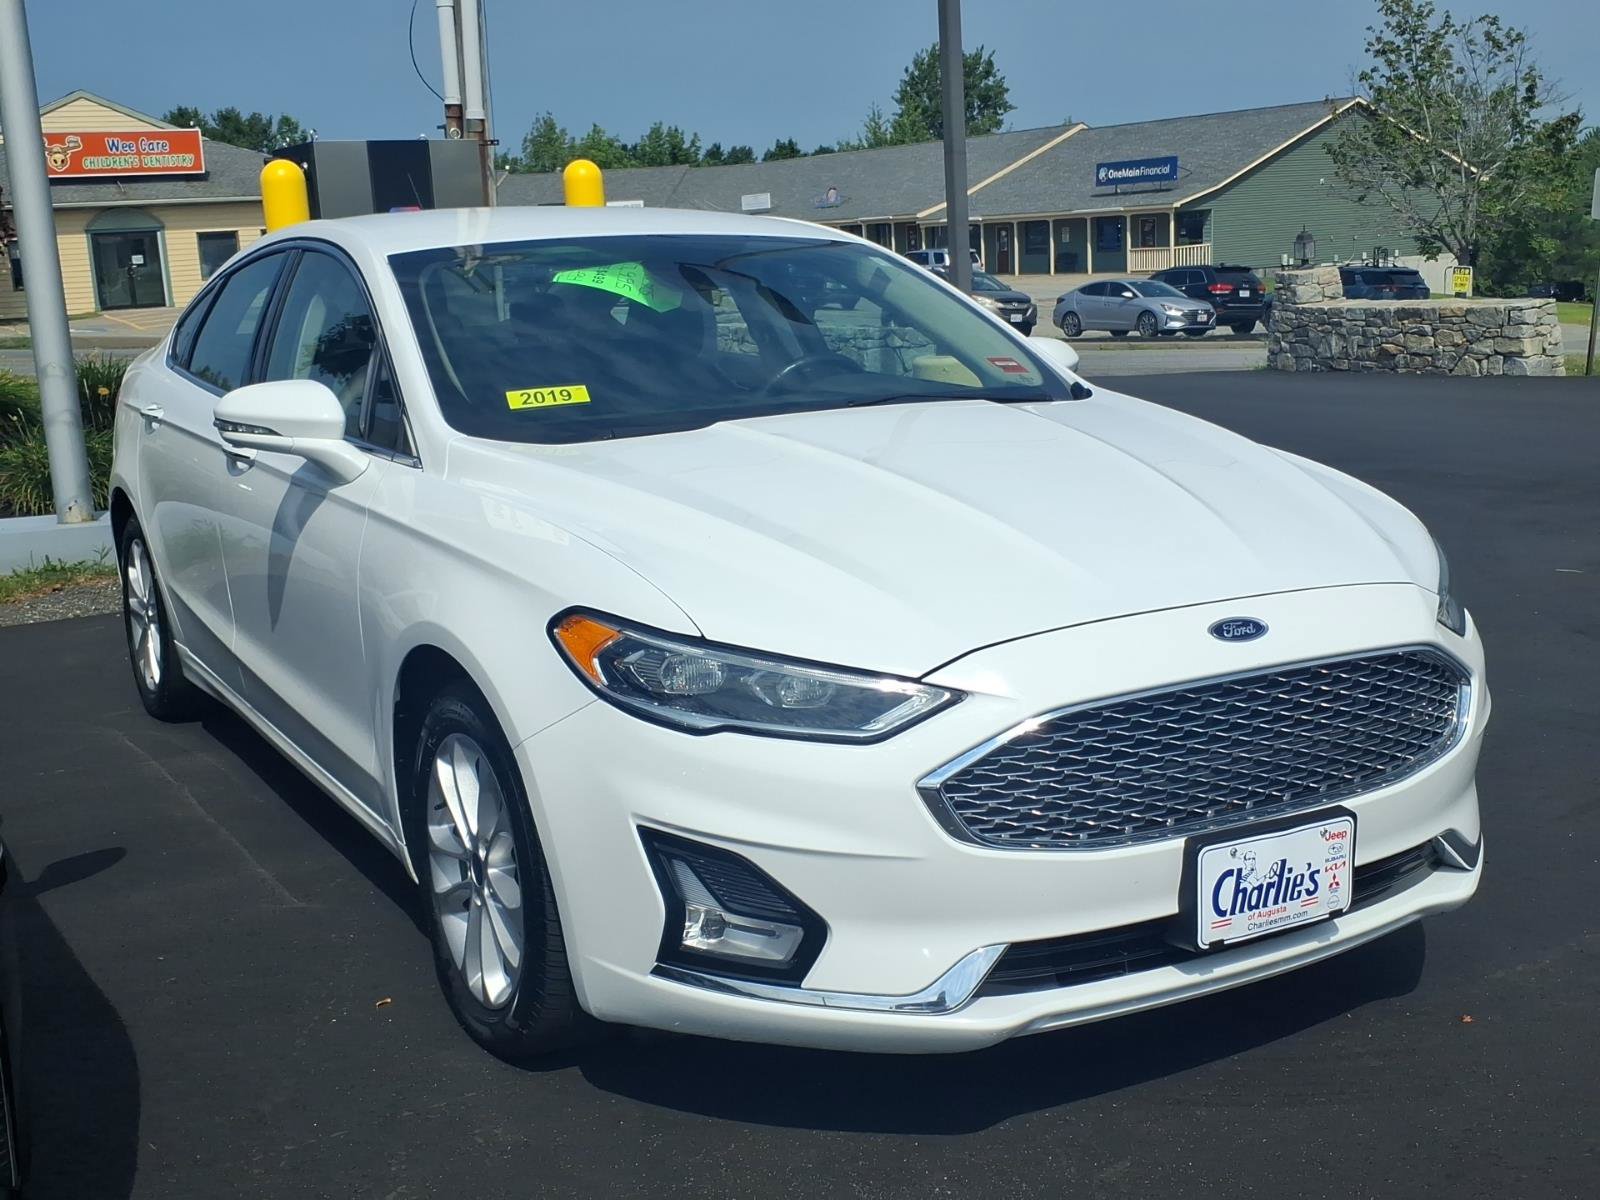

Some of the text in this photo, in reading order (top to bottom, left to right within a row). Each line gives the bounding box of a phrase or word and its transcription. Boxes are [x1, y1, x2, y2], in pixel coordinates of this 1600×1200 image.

[106, 137, 169, 153] Wee Care
[82, 153, 194, 169] CHILDREN'S DENTISTRY
[520, 389, 572, 405] 2019
[1222, 621, 1256, 638] Ford
[1325, 830, 1347, 842] Jeep
[1325, 854, 1347, 863] SUBARU
[1212, 859, 1321, 918] Charlie's
[1247, 905, 1287, 921] of Augusta
[1247, 910, 1308, 932] Charliesmm.com
